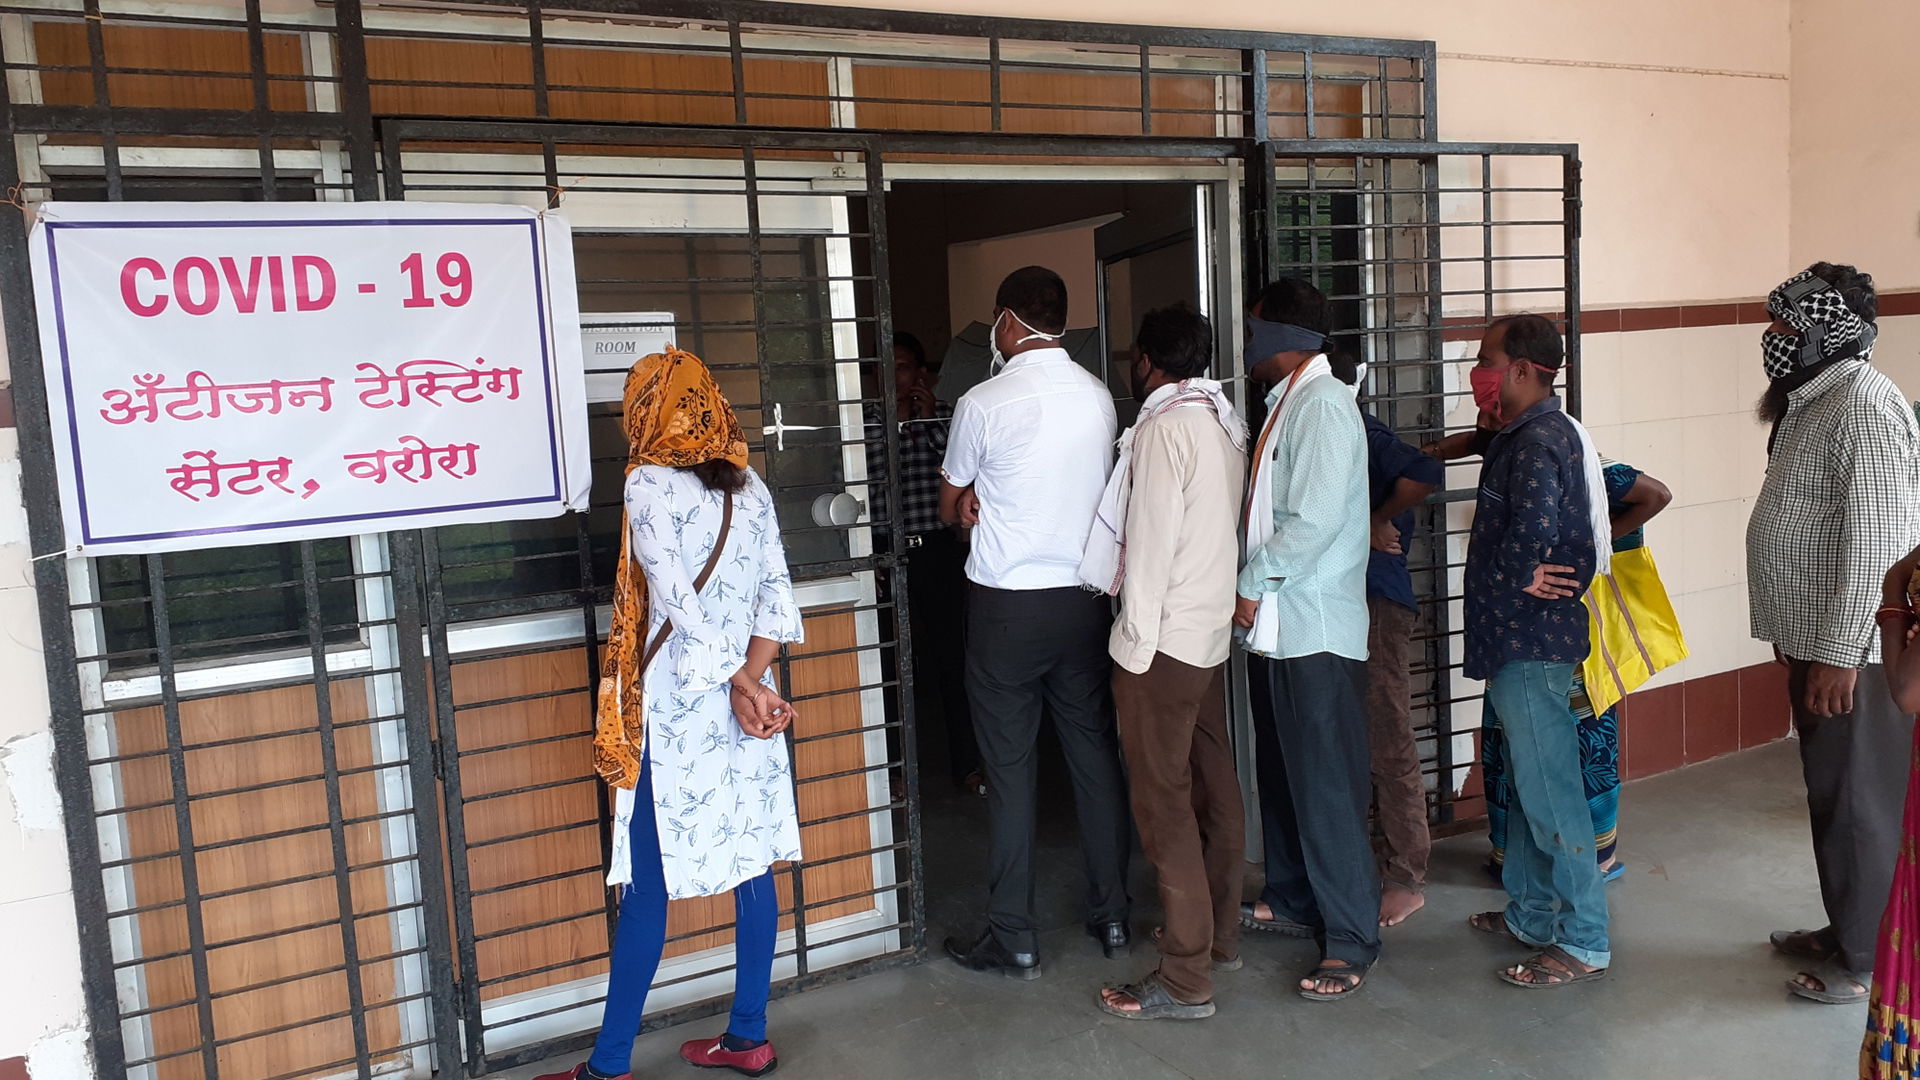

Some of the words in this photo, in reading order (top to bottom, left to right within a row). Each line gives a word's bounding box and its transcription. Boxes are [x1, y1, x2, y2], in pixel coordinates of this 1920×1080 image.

[120, 256, 336, 317] COVID
[358, 283, 377, 294] -
[400, 251, 474, 308] 19
[595, 341, 636, 353] ROOM
[100, 371, 335, 424] अँटीजन
[355, 358, 523, 408] टेस्टिंग
[166, 450, 320, 501] सेंटर,
[343, 436, 480, 483] वरोरा
